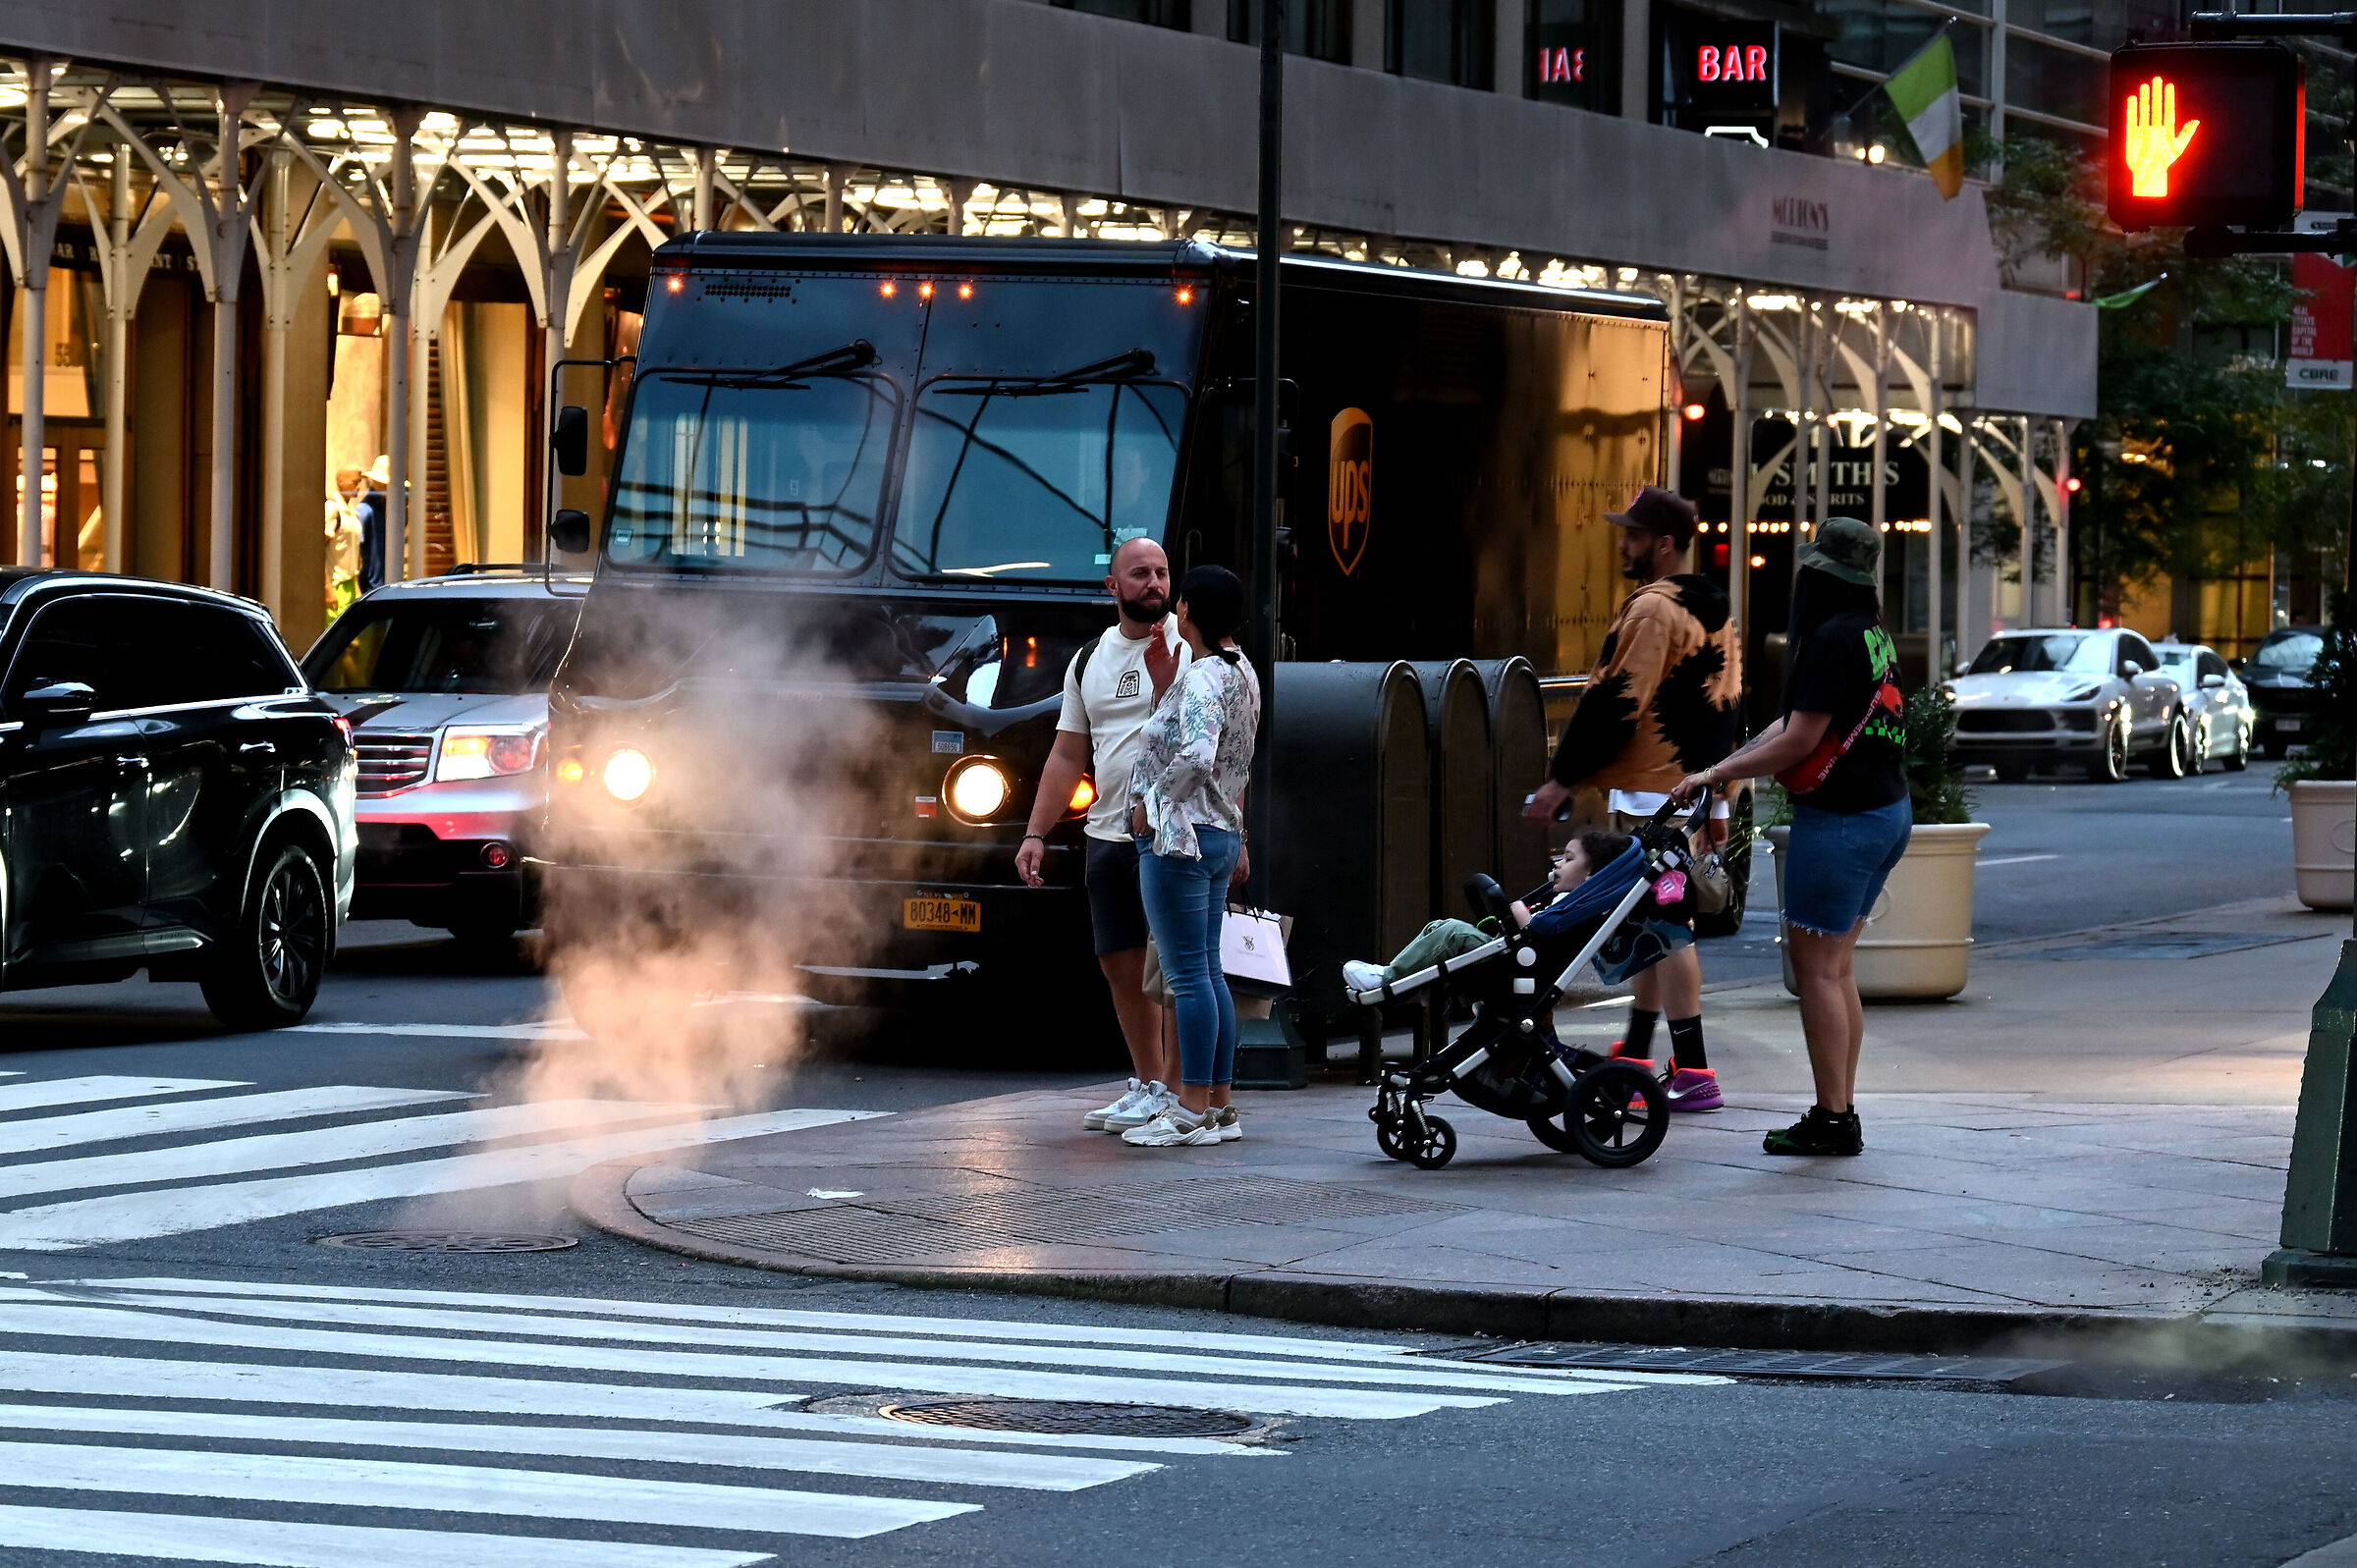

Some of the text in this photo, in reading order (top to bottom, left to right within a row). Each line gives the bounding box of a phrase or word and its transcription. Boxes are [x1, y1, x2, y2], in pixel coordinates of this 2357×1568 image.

[1697, 44, 1768, 81] BAR
[2299, 368, 2339, 381] CBRE
[1331, 460, 1369, 550] ups
[910, 901, 950, 923] 80348
